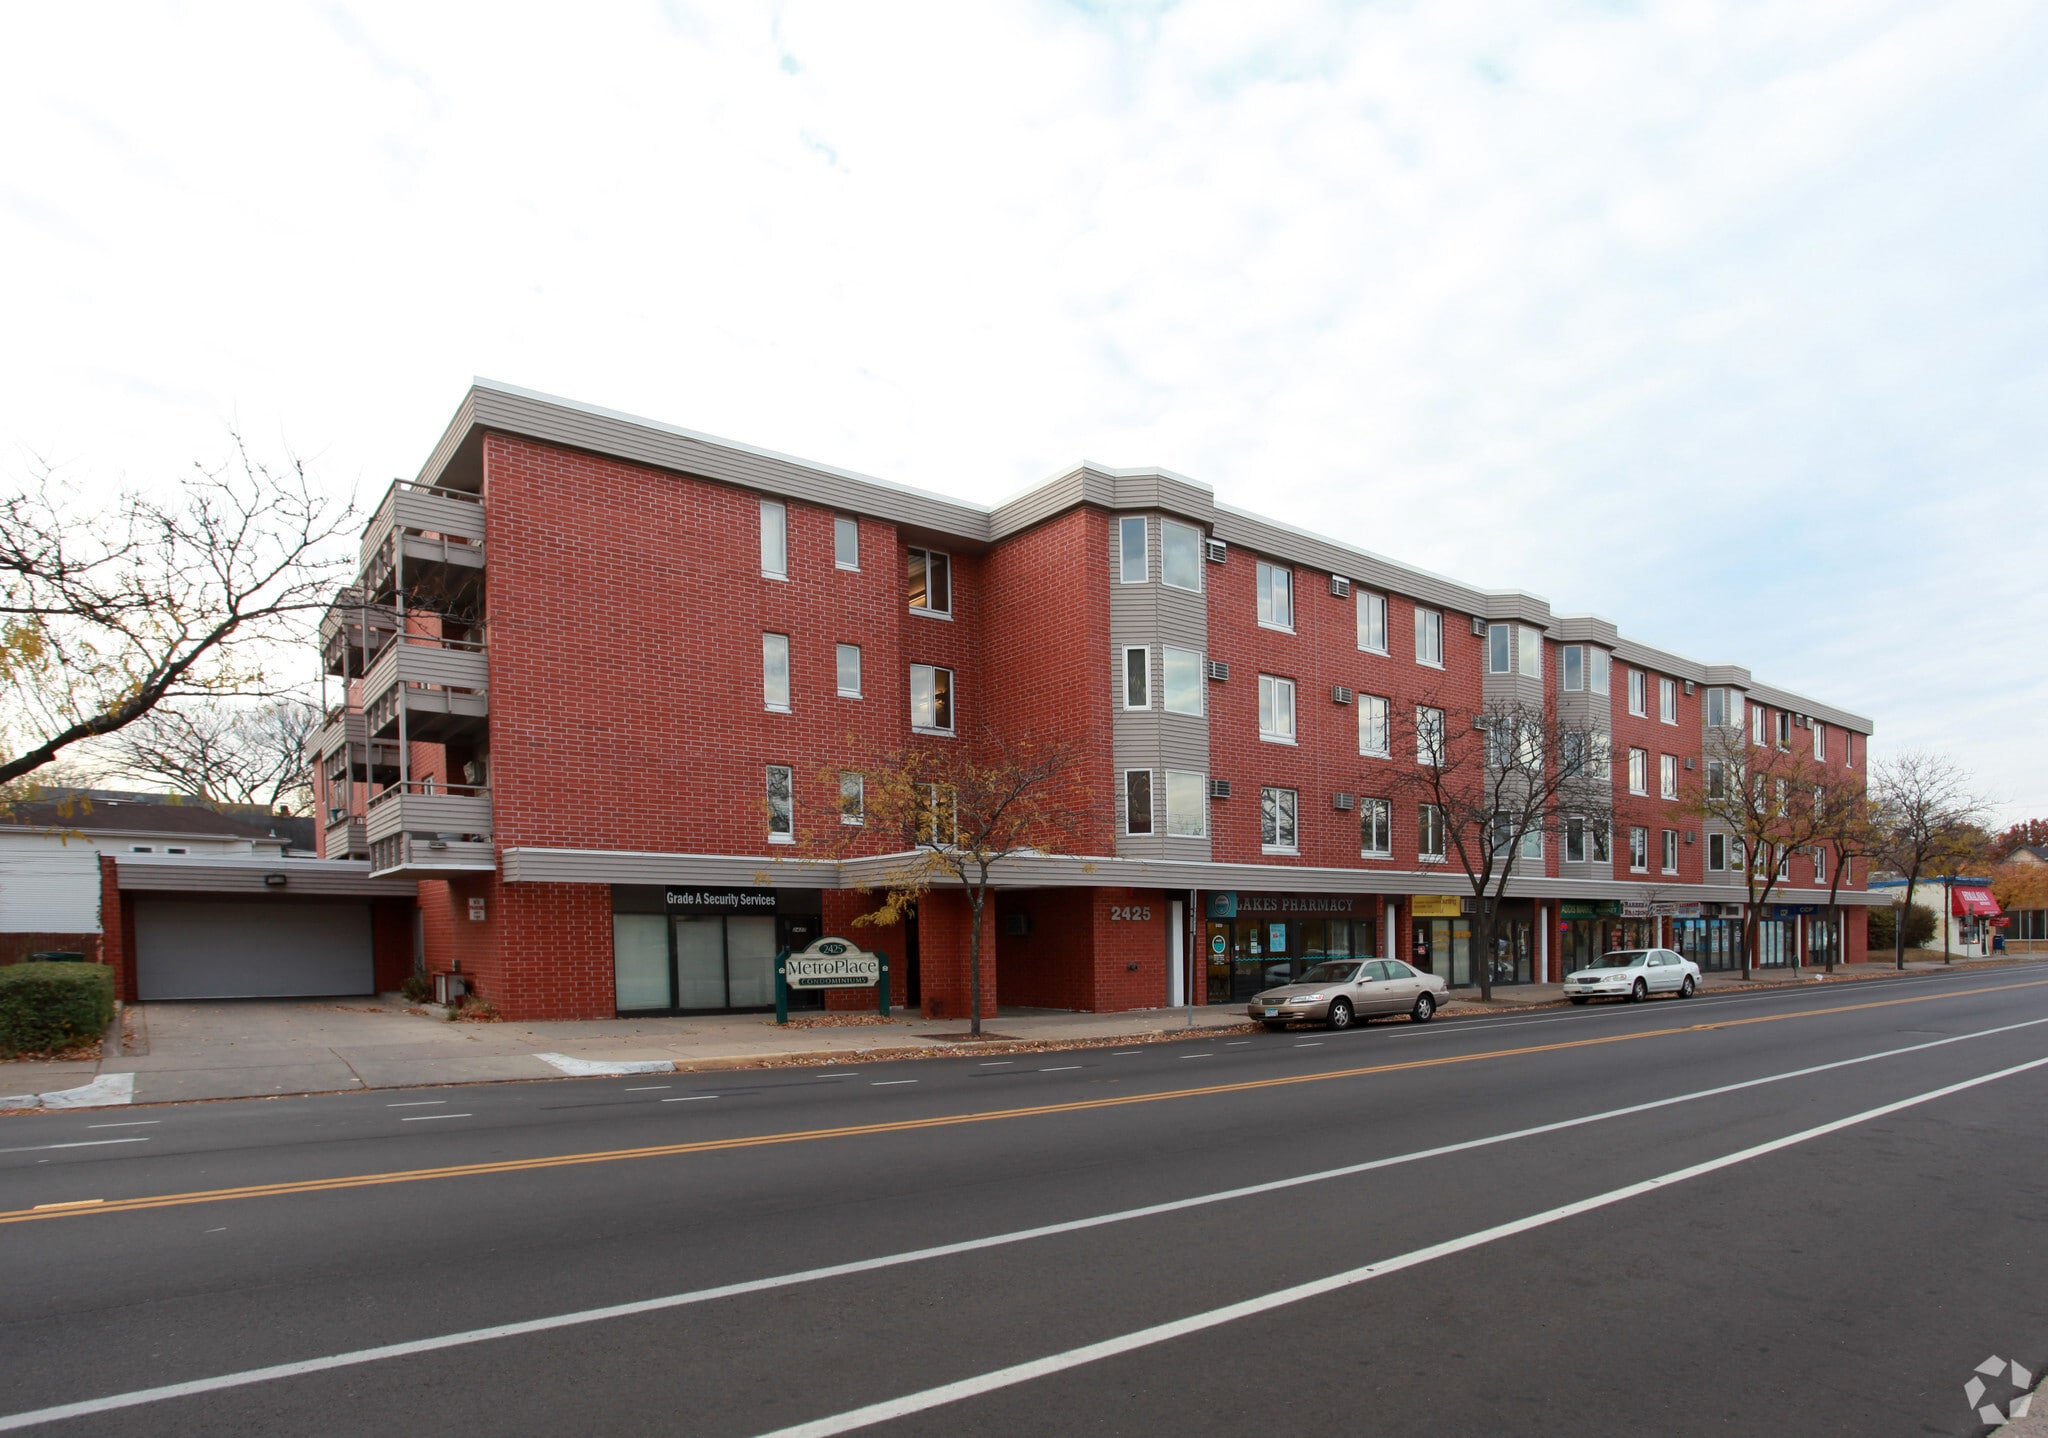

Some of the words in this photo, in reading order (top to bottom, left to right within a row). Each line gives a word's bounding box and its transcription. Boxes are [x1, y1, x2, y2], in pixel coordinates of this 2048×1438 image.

[666, 891, 694, 904] Grade
[695, 892, 702, 904] A
[703, 892, 739, 908] Security
[740, 893, 776, 906] Services
[1281, 898, 1354, 911] PHARMACY
[1111, 906, 1151, 920] 2425
[823, 944, 843, 954] 2425
[788, 959, 877, 976] MetroPlace
[801, 977, 867, 985] CONDOMINIUMS
